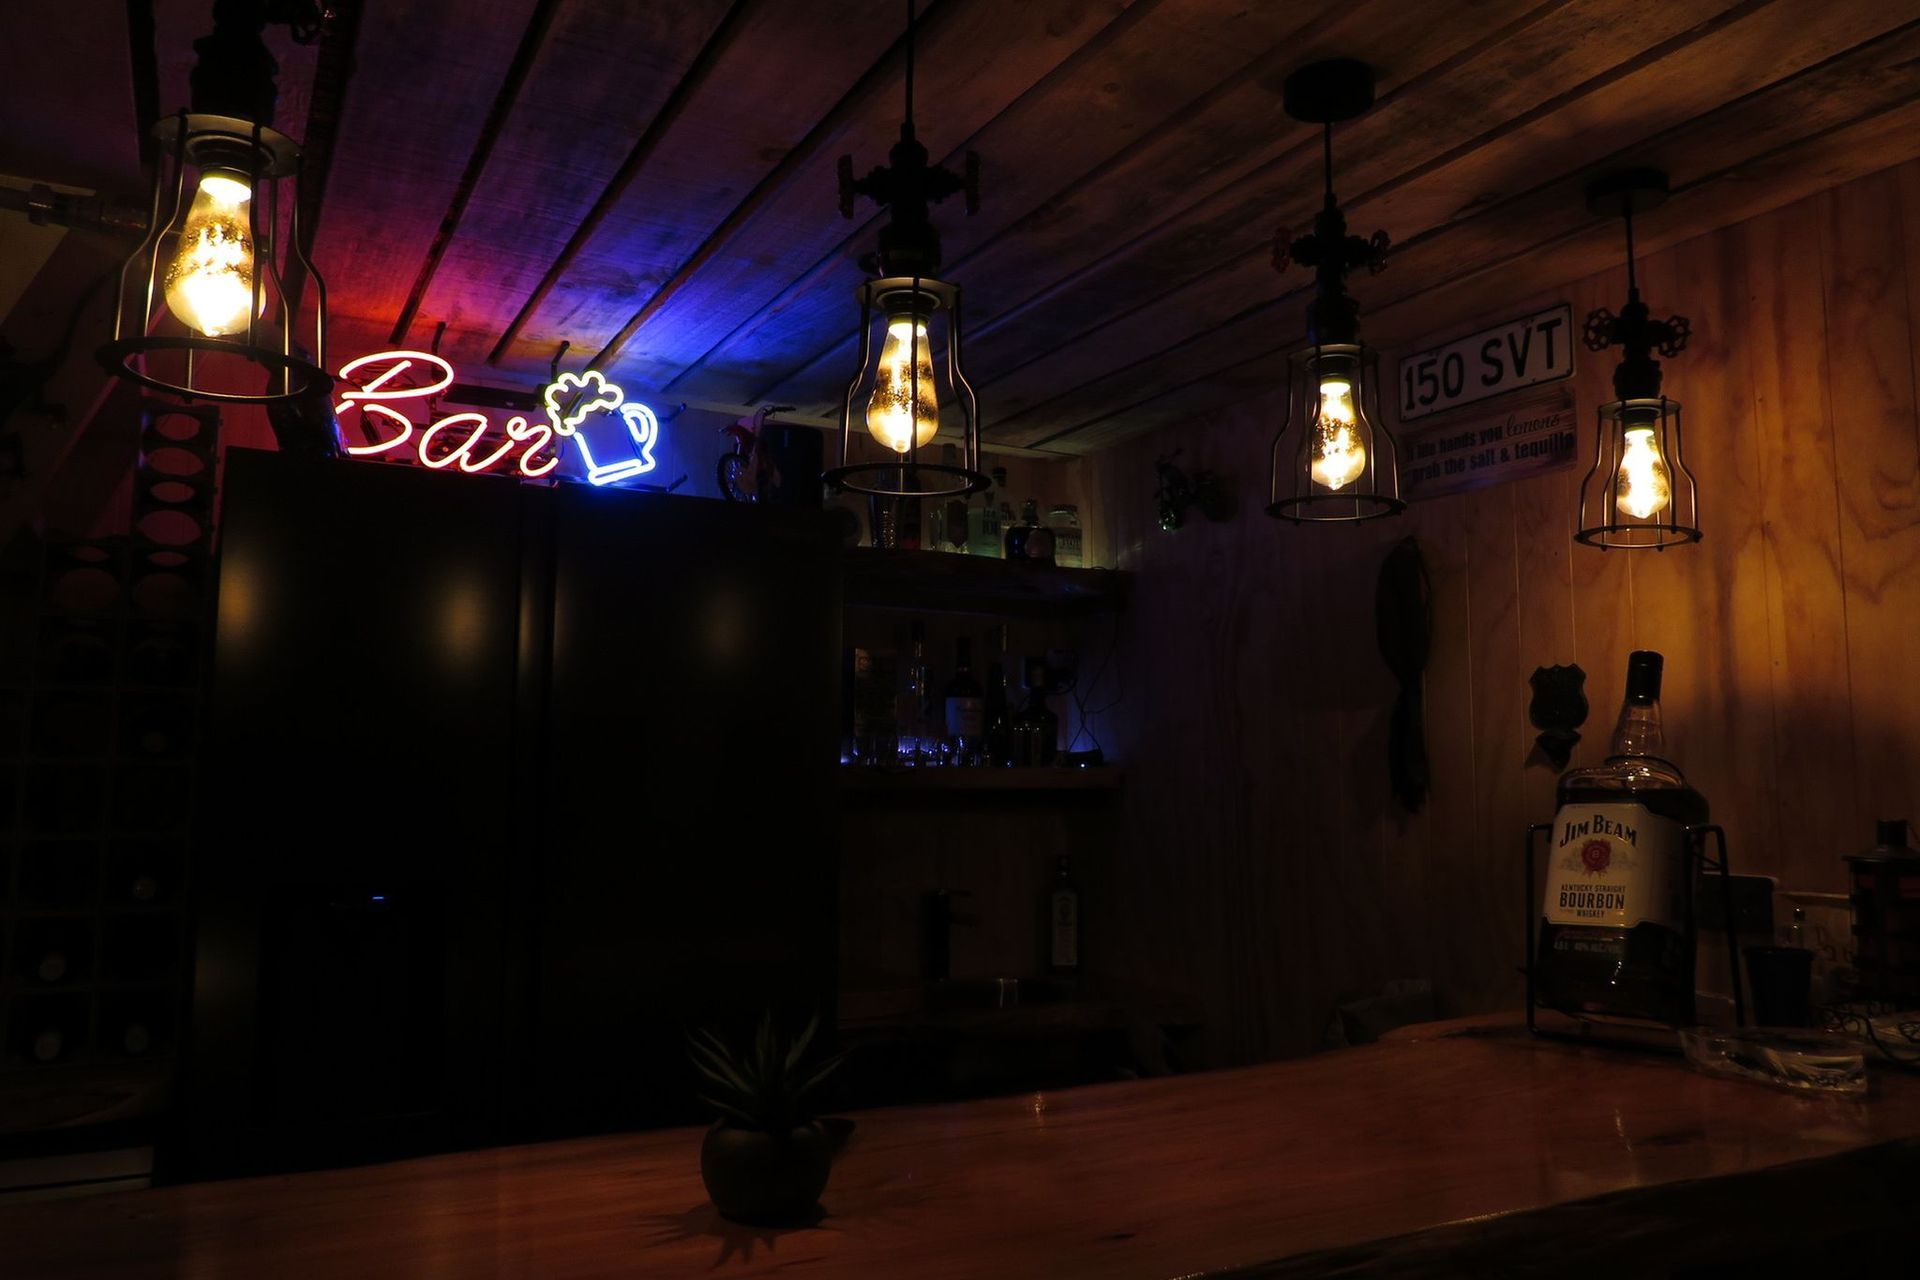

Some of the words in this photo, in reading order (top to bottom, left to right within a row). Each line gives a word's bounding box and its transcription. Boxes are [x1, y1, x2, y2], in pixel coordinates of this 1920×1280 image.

[1405, 352, 1464, 410] 150
[1481, 317, 1562, 386] SVT
[335, 350, 559, 477] Bar
[1439, 431, 1476, 454] hands
[1478, 425, 1504, 446] you
[1444, 457, 1466, 475] the
[1470, 448, 1495, 470] salt
[1500, 447, 1511, 463] &
[1560, 820, 1590, 848] JIM
[1592, 814, 1637, 848] BEAM
[1560, 892, 1625, 910] BOURBON
[1576, 909, 1606, 919] WHISKEY
